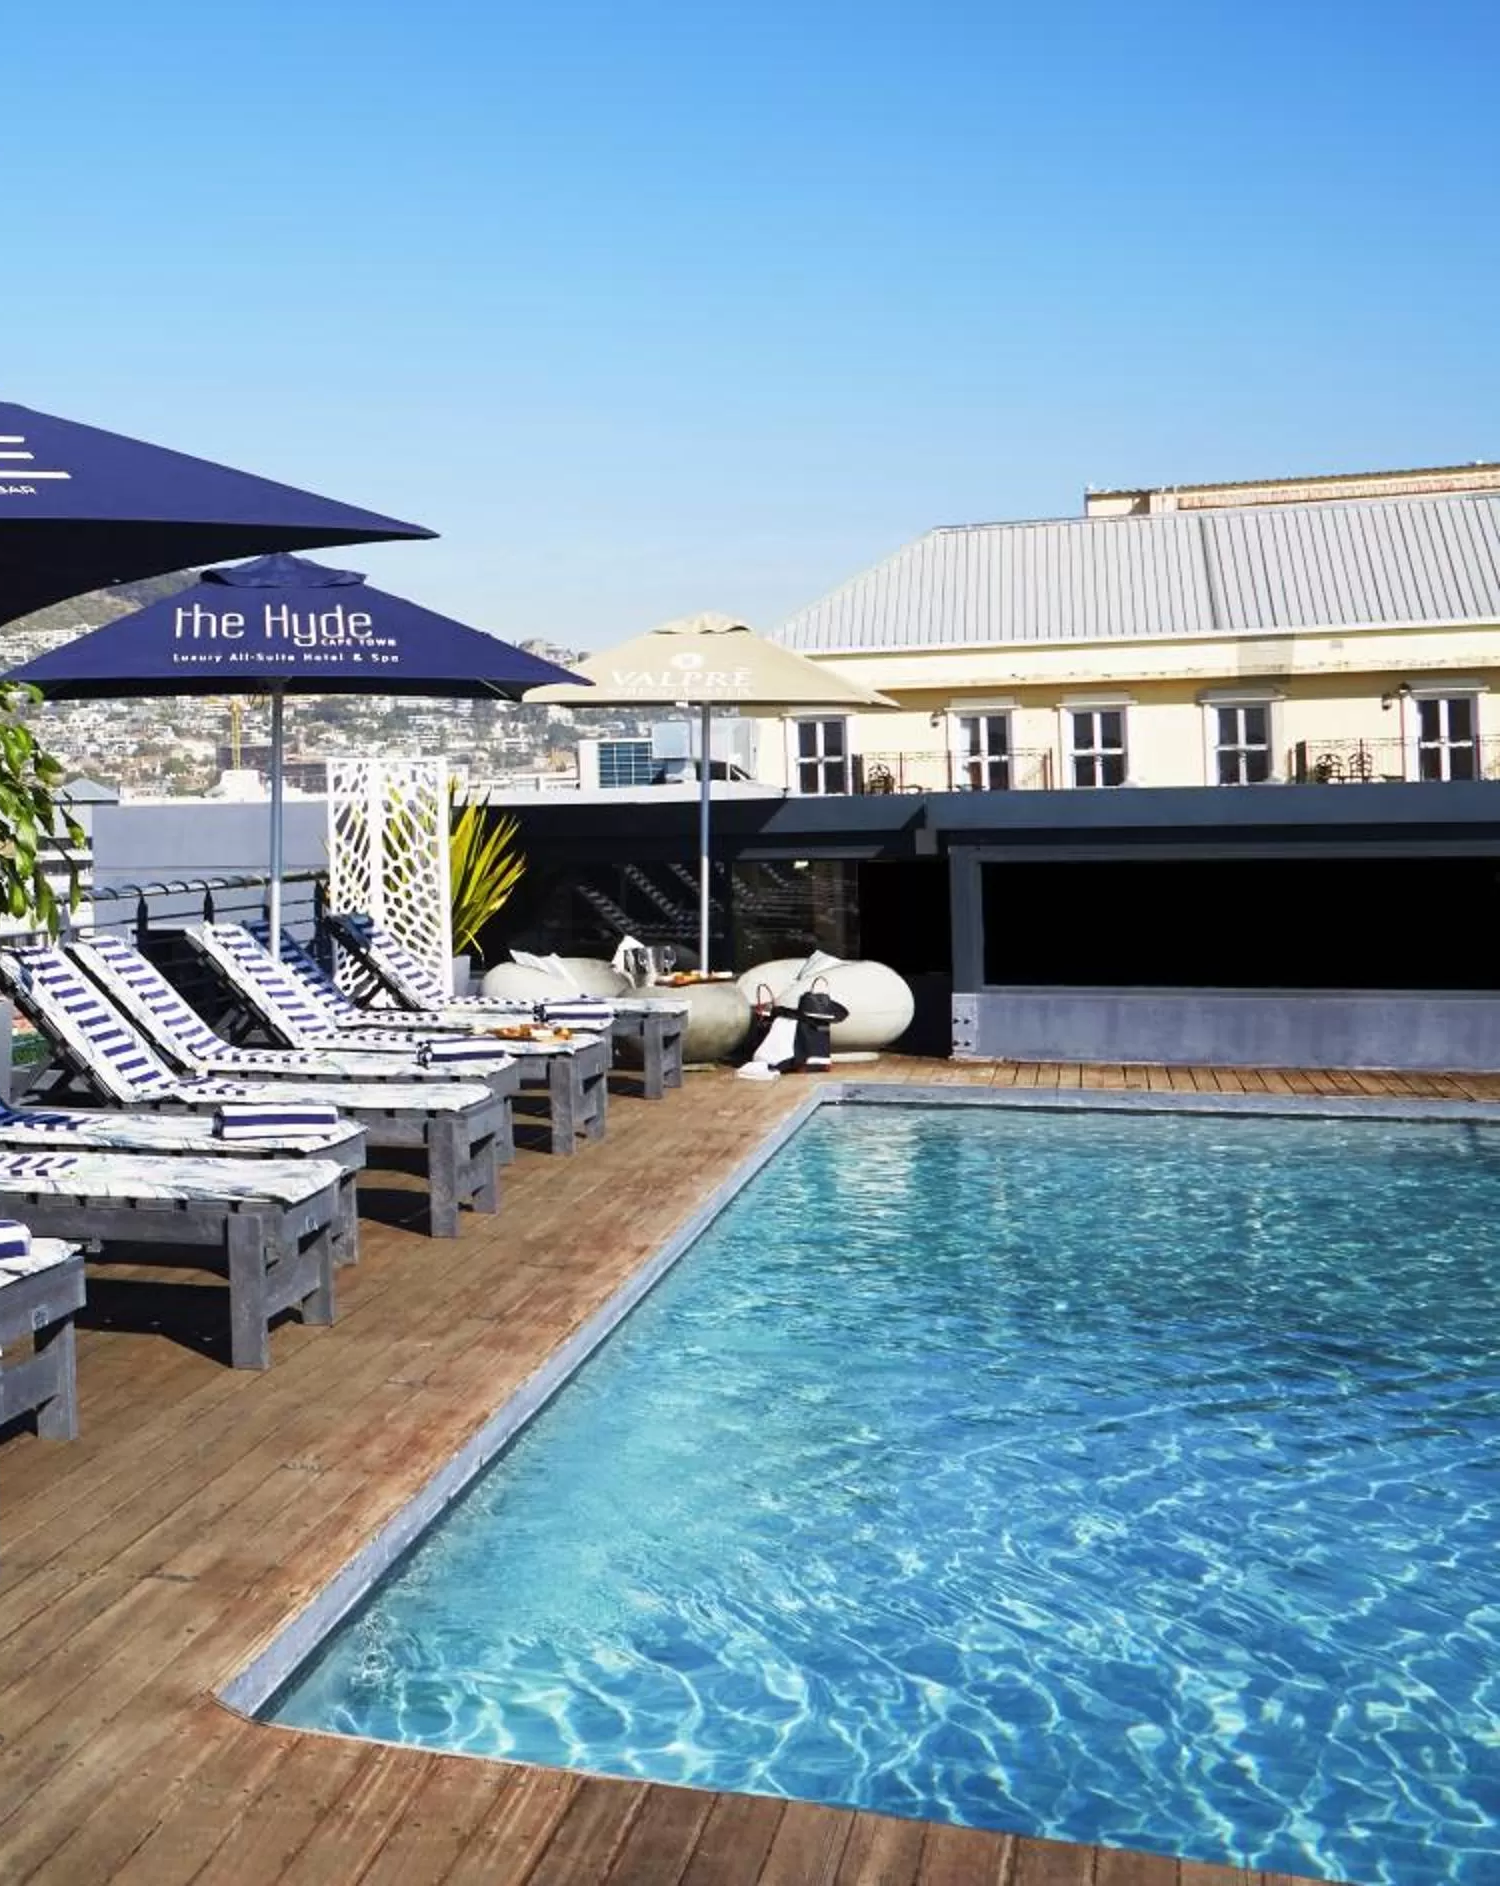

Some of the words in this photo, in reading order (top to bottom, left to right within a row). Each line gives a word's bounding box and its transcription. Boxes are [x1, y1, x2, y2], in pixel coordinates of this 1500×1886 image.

[175, 603, 245, 639] the
[265, 603, 373, 647] Hyde
[320, 637, 352, 647] CAPE
[357, 637, 397, 647] TOWN
[173, 653, 222, 663] Luxury
[229, 652, 295, 662] All-Suite
[303, 652, 344, 662] Hotel
[371, 653, 400, 663] Spa
